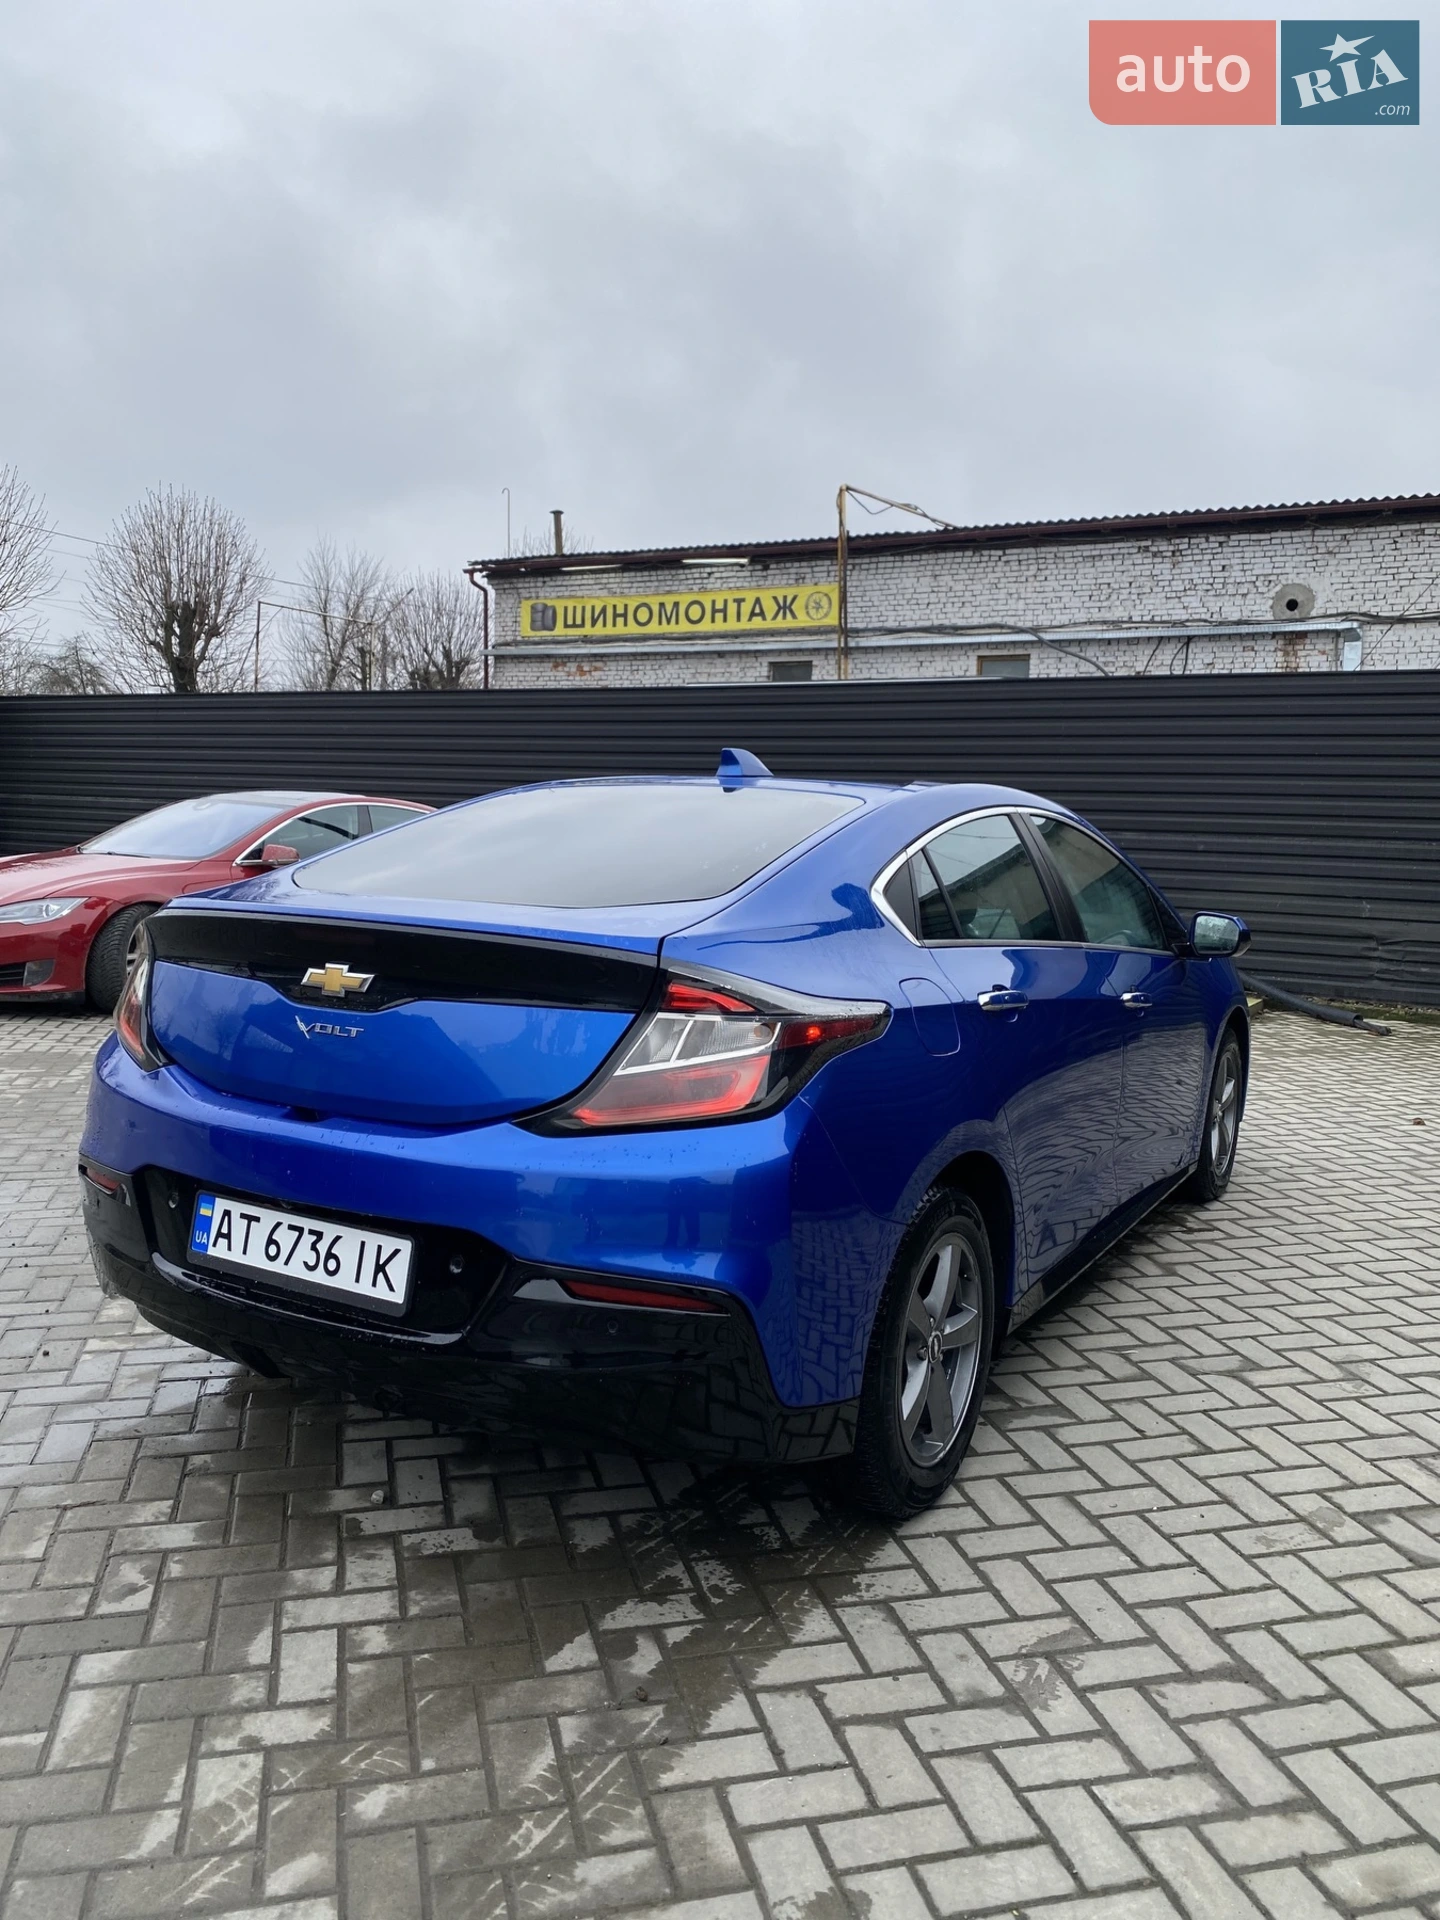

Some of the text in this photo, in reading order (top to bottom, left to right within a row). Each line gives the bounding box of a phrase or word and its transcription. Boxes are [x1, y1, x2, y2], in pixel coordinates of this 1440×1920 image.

[563, 594, 798, 629] ШИНОМОНТАЖ
[295, 1015, 364, 1039] VOLT
[195, 1230, 208, 1244] UA
[212, 1209, 402, 1293] AT 6736 IK
